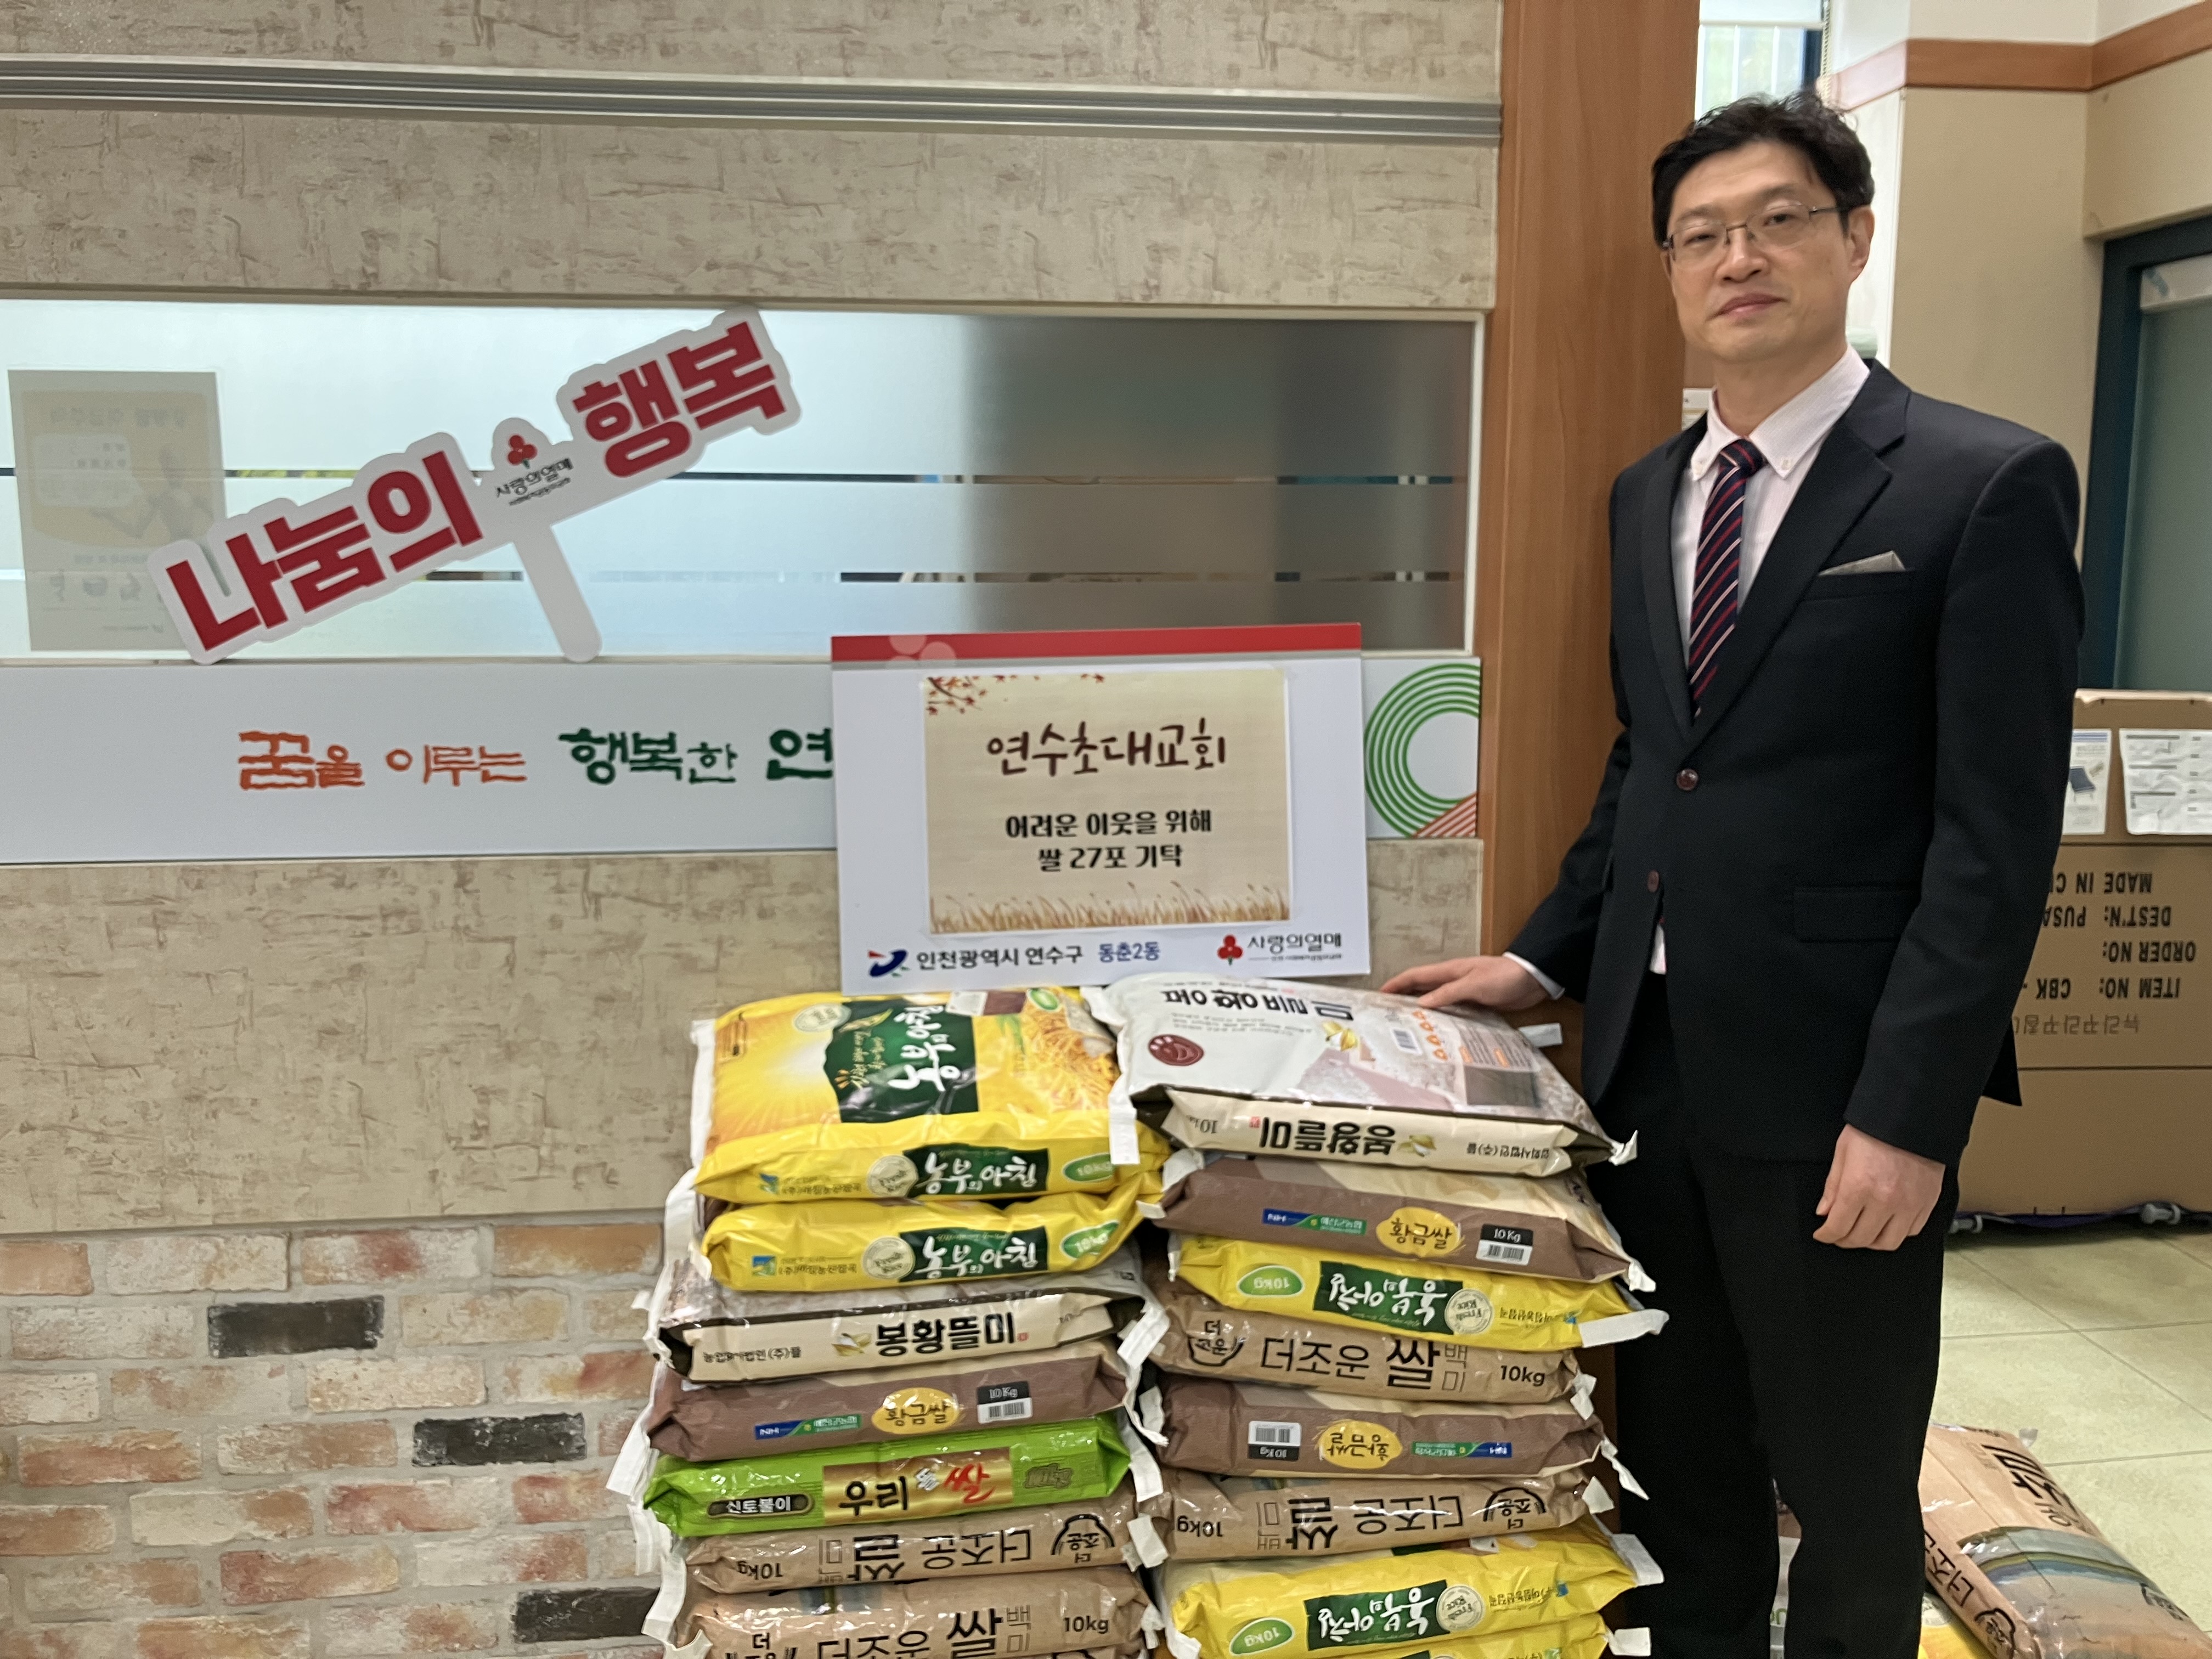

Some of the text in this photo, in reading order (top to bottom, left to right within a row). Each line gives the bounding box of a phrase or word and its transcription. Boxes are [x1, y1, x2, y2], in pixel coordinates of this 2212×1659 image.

[166, 320, 786, 652] 나눔의 행복
[239, 731, 365, 790] 꿈을
[385, 744, 527, 786] 이루는
[558, 727, 737, 785] 행복한
[987, 717, 1227, 777] 연수초대교회
[1005, 809, 1212, 839] 어려운 이웃을 위해
[1037, 844, 1183, 872] 쌀 27포 기탁
[2050, 872, 2153, 895] MADE IN C
[2103, 905, 2172, 928] DEST'N:
[917, 945, 1084, 971] 인천광역시 연수구
[1098, 941, 1160, 963] 동춘2동
[1247, 932, 1342, 955] 사랑의열매
[2102, 941, 2197, 963] ORDER NO:
[2036, 977, 2072, 1000] CBK
[2098, 977, 2130, 1000] NO:
[2138, 977, 2181, 1000] ITEM
[1259, 1116, 1397, 1158] 봉황뜰미
[1390, 1217, 1453, 1247] 황금쌀
[875, 1312, 1015, 1357] 봉황뜰미
[1261, 1336, 1370, 1380] 더조운
[1385, 1337, 1442, 1390] 쌀
[1500, 1364, 1546, 1387] 10kg
[885, 1397, 960, 1428] 황금쌀
[1327, 1432, 1390, 1462] 황금쌀
[725, 1496, 792, 1515] 신토불이
[1353, 1494, 1464, 1536] 더조운
[1176, 1516, 1223, 1539] 10kg
[1286, 1497, 1339, 1551] 쌀
[848, 1534, 905, 1583] 쌀
[922, 1531, 1032, 1571] 더조운
[736, 1560, 783, 1579] 10kg
[1063, 1616, 1109, 1634] 10kg
